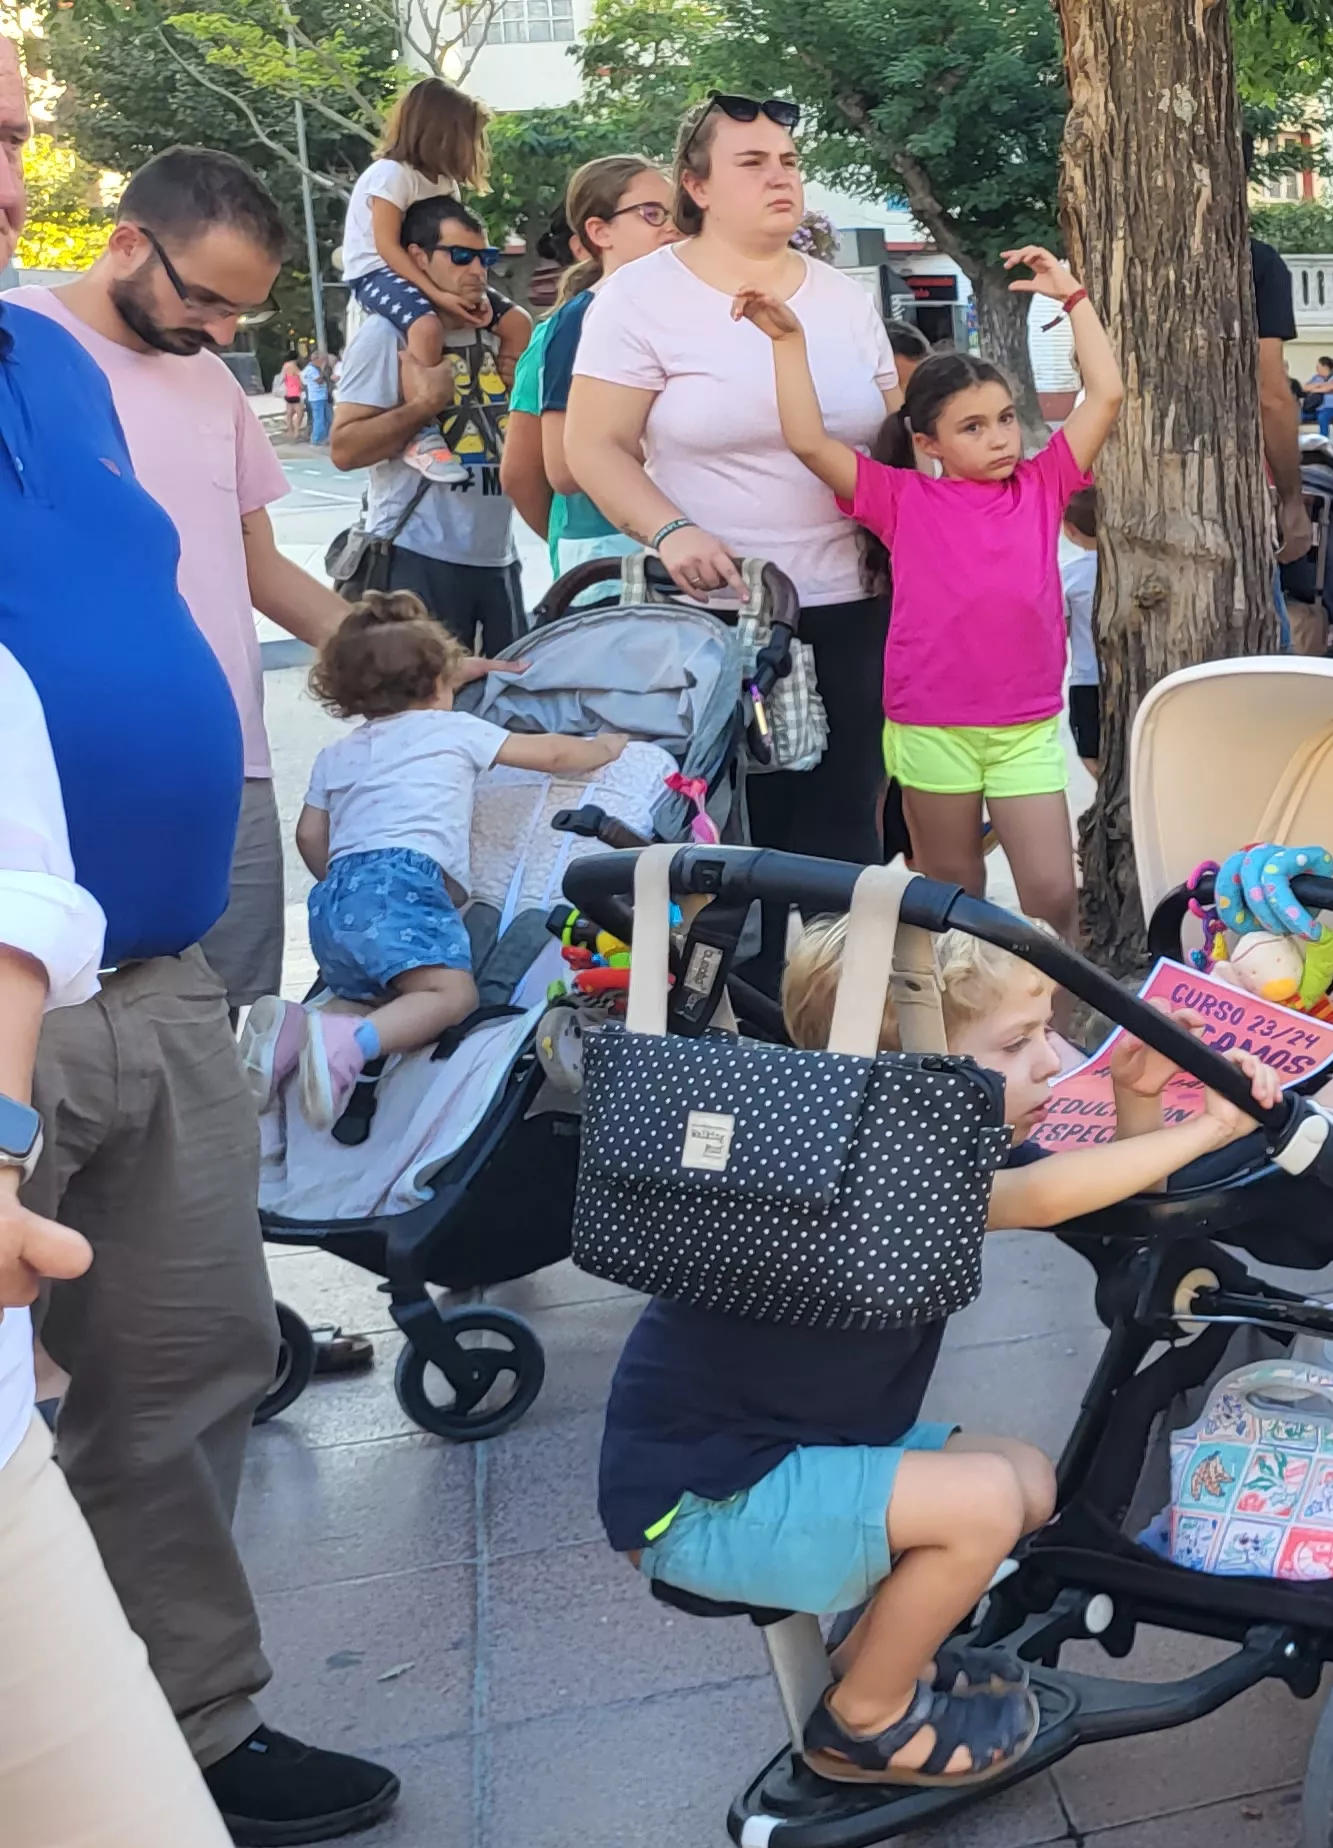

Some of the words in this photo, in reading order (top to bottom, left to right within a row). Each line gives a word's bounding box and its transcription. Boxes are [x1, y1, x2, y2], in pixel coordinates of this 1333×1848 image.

[1171, 983, 1245, 1026] CURSO
[1247, 1015, 1321, 1050] 23/24
[1029, 1123, 1117, 1143] ESPEC
